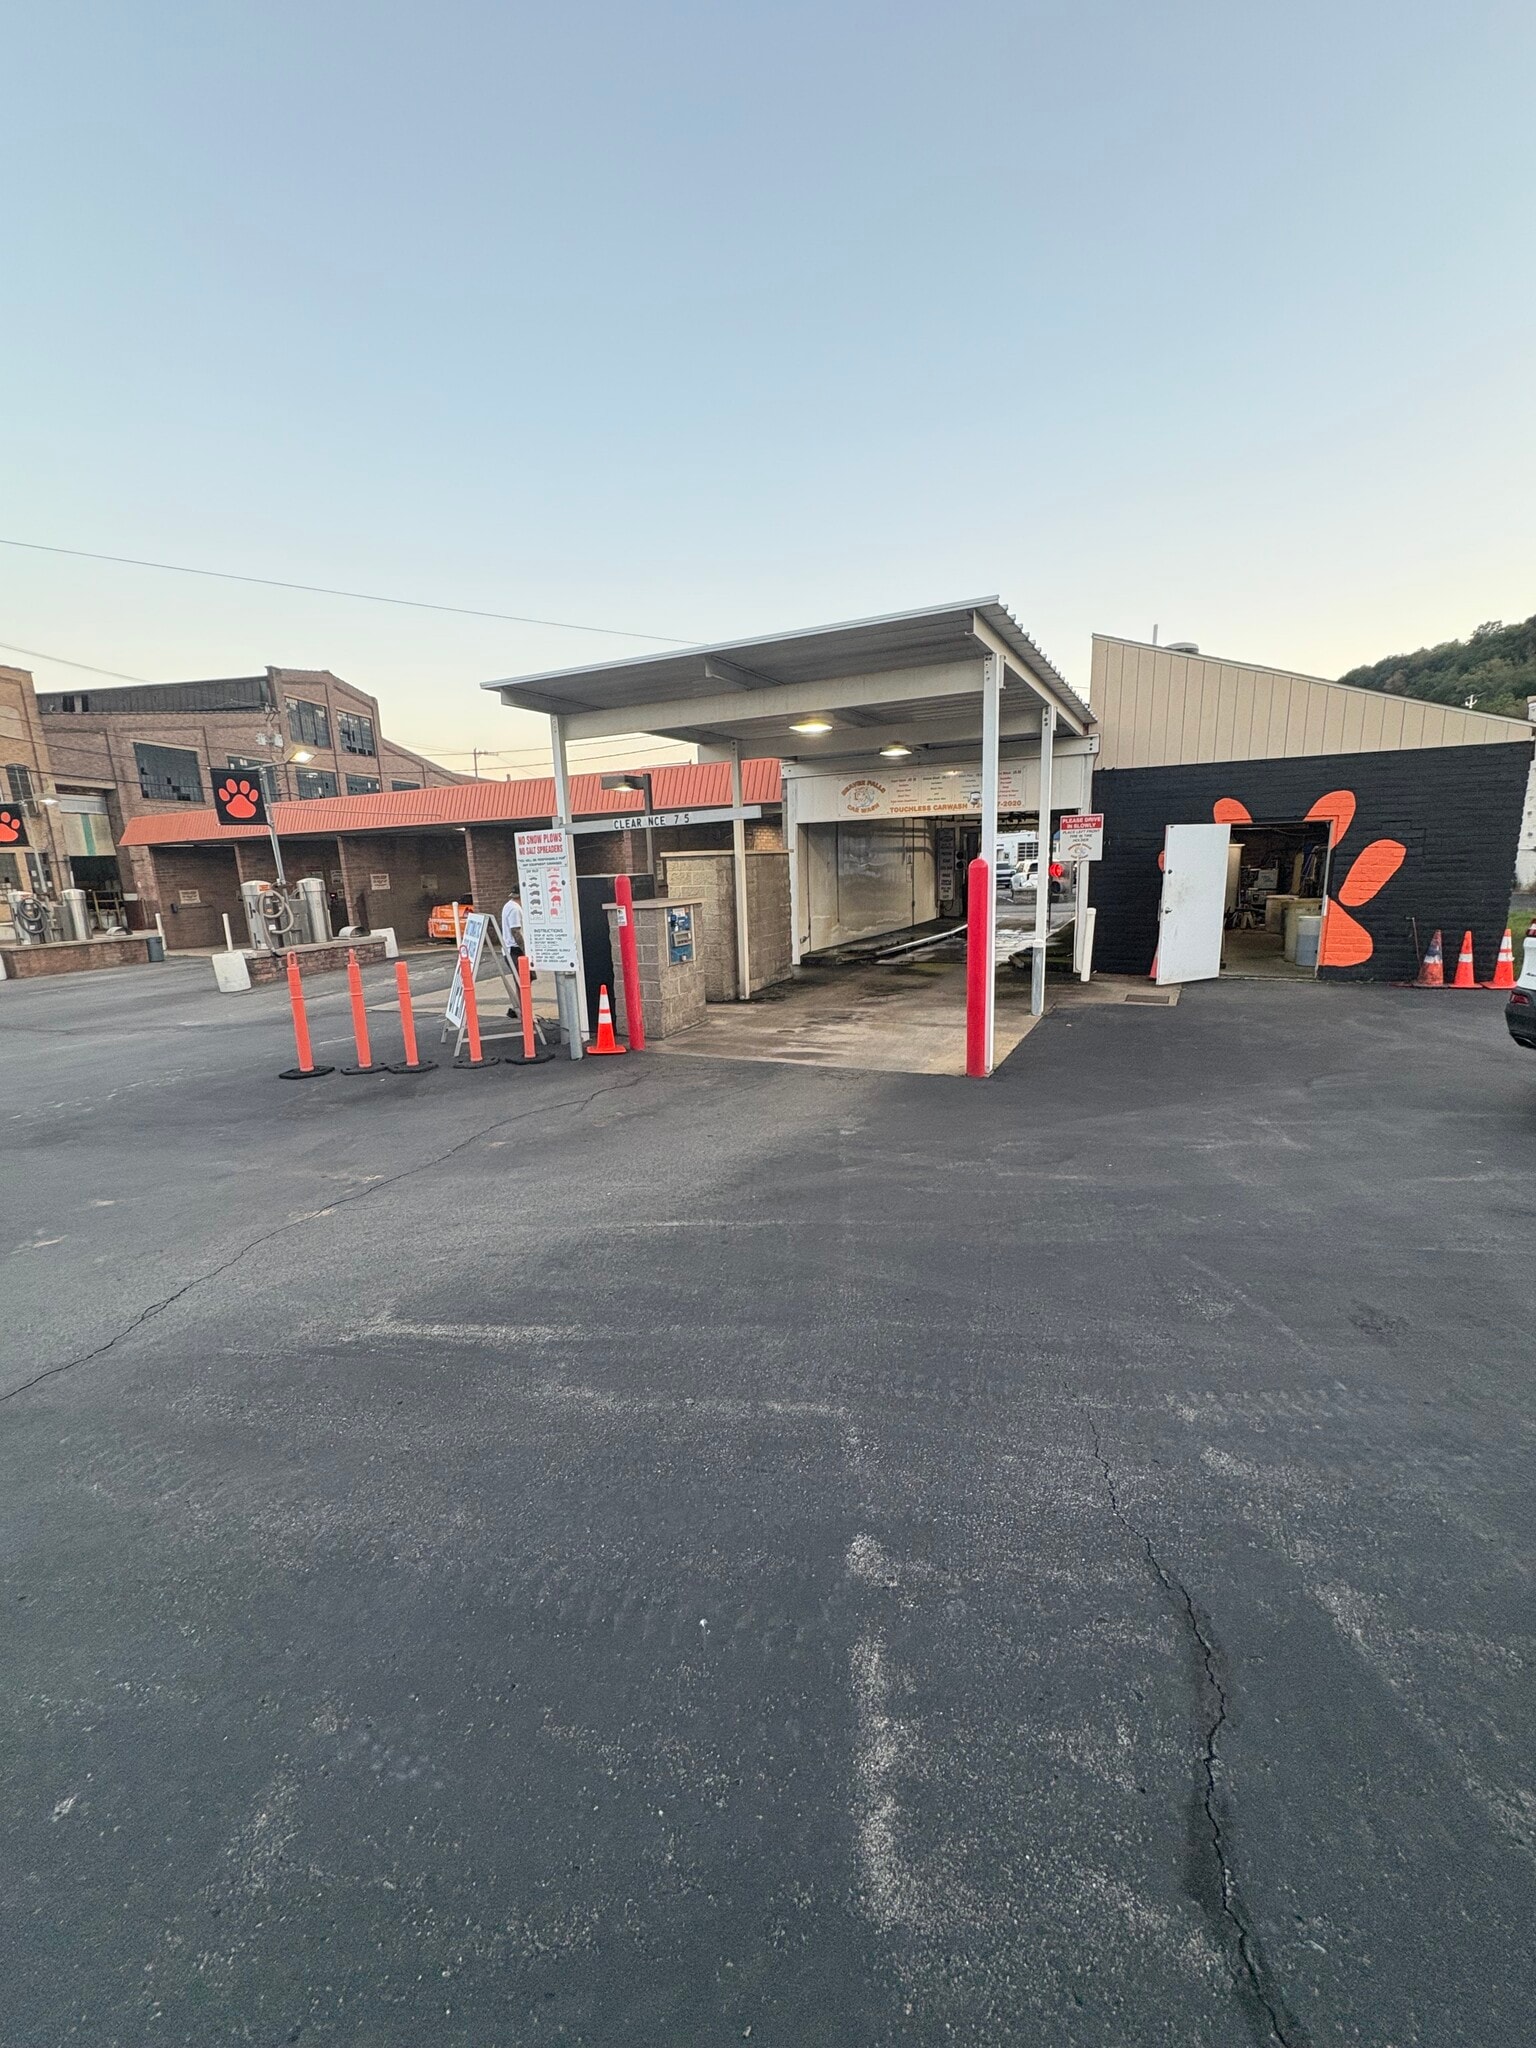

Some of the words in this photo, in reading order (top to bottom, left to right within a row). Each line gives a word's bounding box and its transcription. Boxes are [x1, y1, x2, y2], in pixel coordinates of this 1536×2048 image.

[890, 805, 931, 813] TOUCHLESS
[674, 815, 678, 824] 7
[684, 814, 689, 823] 5
[518, 836, 525, 845] NO
[526, 835, 542, 844] SNOW
[543, 832, 562, 843] PLOWS
[526, 846, 536, 855] SALT
[537, 845, 563, 854] SPREADERS
